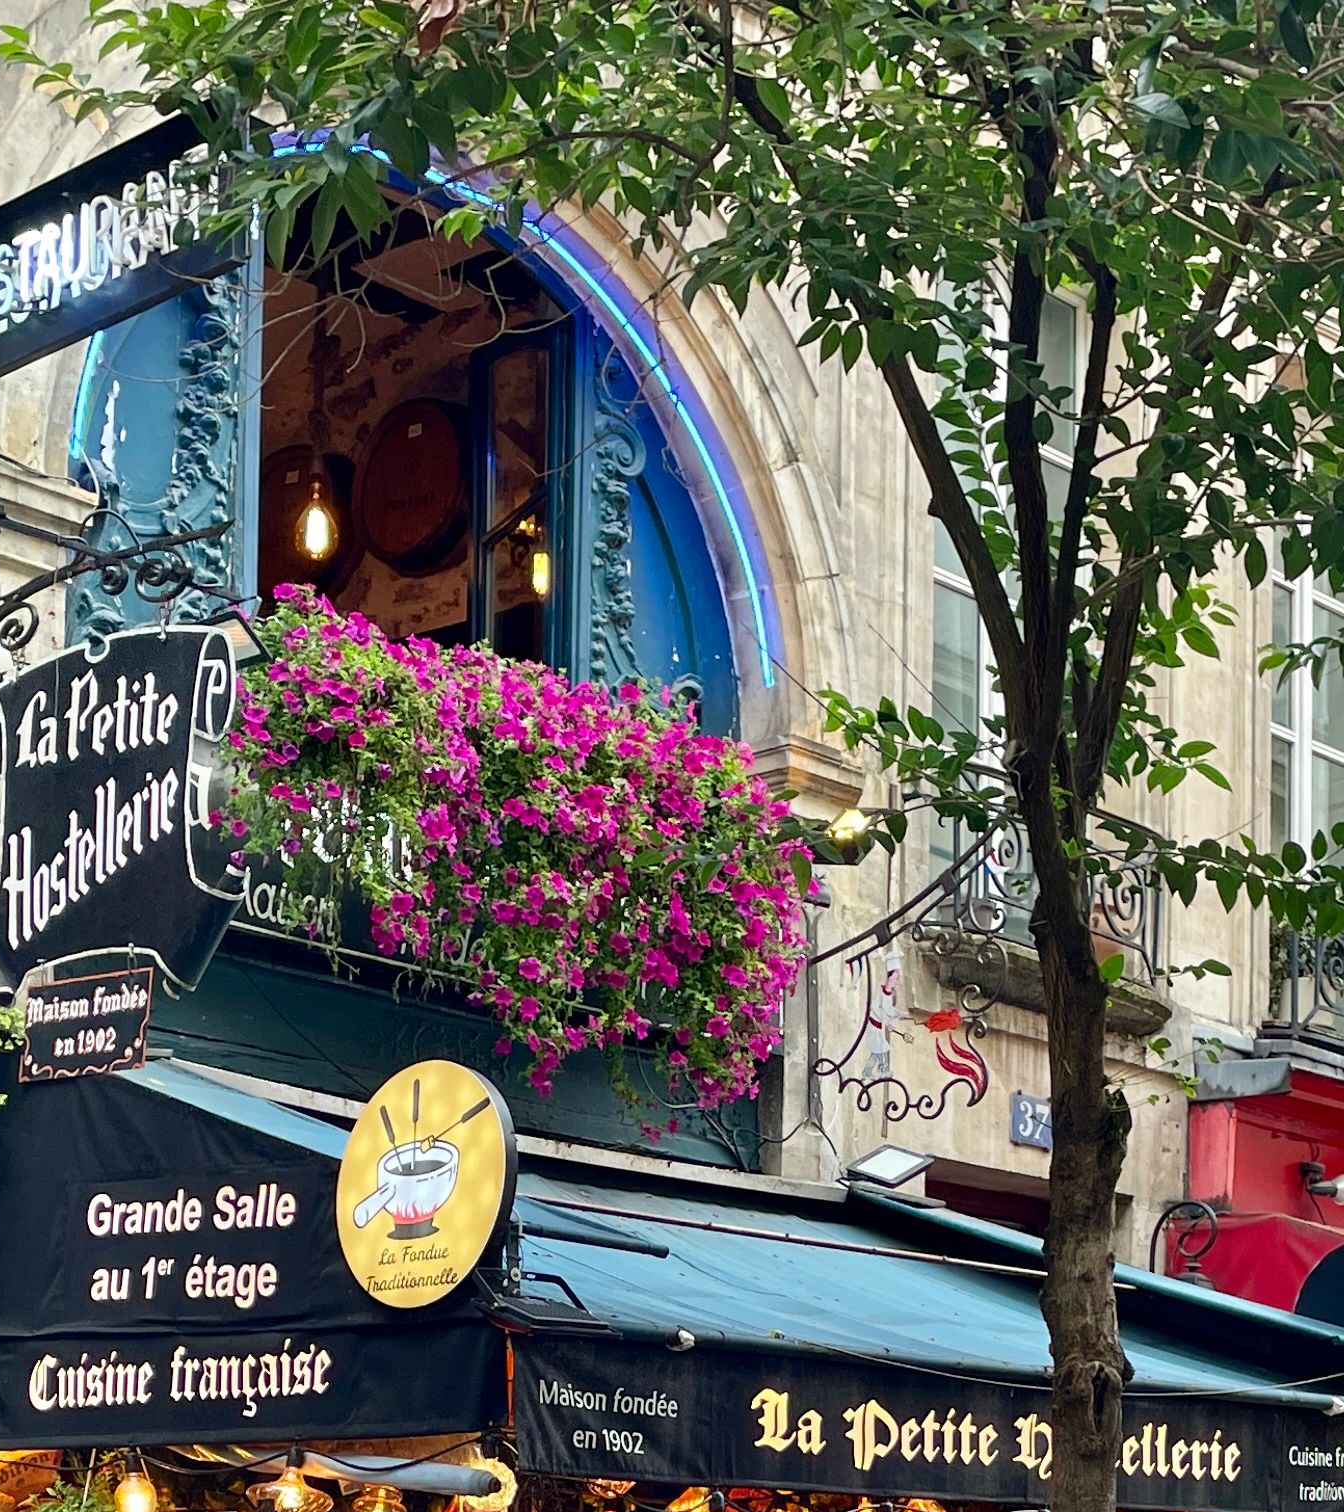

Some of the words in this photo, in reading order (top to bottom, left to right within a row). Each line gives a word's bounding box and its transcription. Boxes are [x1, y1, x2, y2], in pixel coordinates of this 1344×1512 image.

[15, 691, 58, 768] La
[64, 669, 178, 761] Petite
[3, 768, 178, 950] Hostellerie
[26, 996, 89, 1027] Maison
[53, 1036, 76, 1057] en
[77, 1026, 117, 1055] 1902
[1019, 1101, 1050, 1140] 37
[88, 1188, 202, 1237] Grande
[213, 1183, 296, 1231] Salle
[378, 1247, 398, 1267] La
[402, 1243, 450, 1262] Fondue
[90, 1266, 130, 1300] au
[185, 1254, 278, 1308] étage
[366, 1267, 459, 1294] Traditionnelle
[29, 1351, 154, 1411] Cuisine
[169, 1337, 332, 1418] française
[539, 1379, 607, 1411] Maison
[613, 1386, 679, 1418] fondée
[573, 1429, 597, 1449] en
[601, 1428, 645, 1455] 1902
[751, 1388, 827, 1455] La
[842, 1400, 1000, 1472] Petite
[1289, 1446, 1333, 1467] Cuisine
